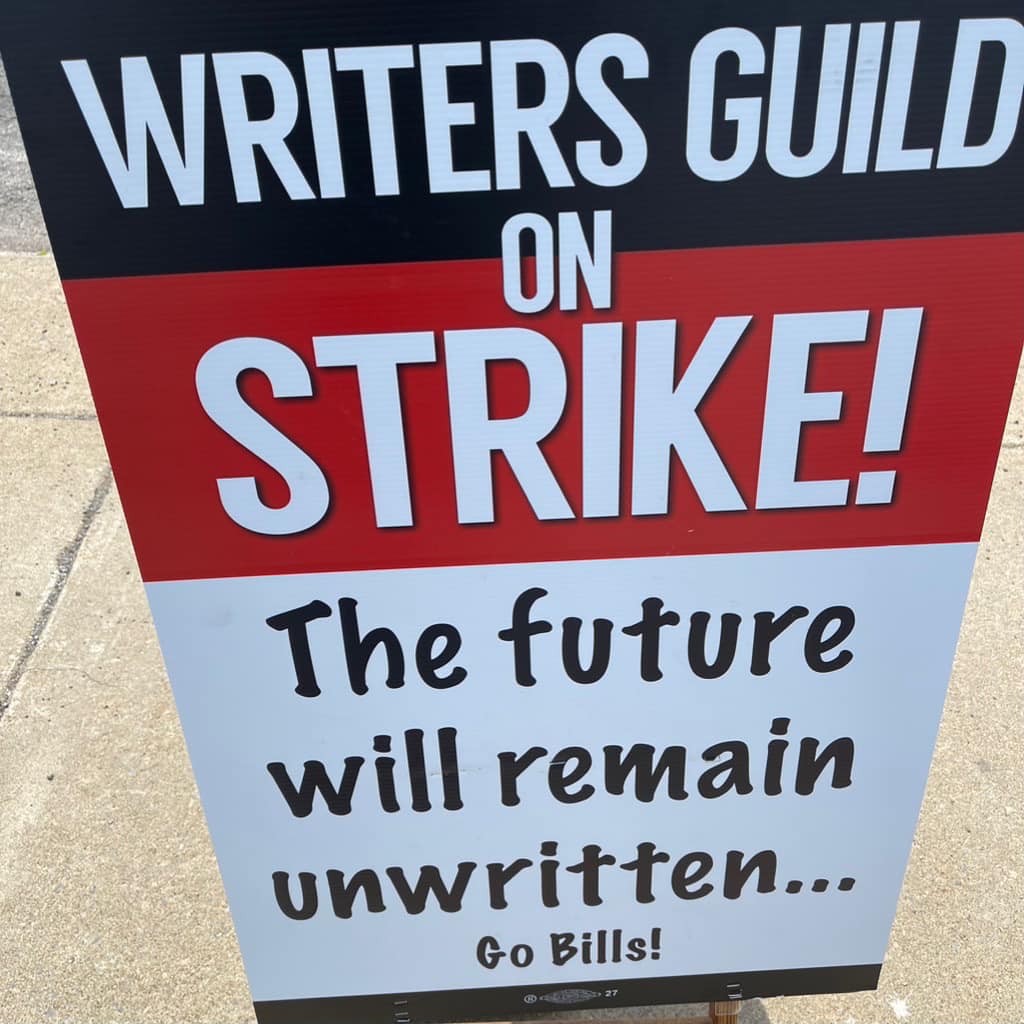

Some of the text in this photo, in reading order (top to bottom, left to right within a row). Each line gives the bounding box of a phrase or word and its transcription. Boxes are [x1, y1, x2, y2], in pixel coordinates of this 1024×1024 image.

[62, 18, 1023, 209] WRITERS GUILD
[500, 210, 613, 314] ON
[195, 307, 924, 535] STRIKE!
[266, 587, 856, 698] The future
[267, 717, 856, 818] will remain
[271, 839, 856, 921] unwritten...
[476, 927, 663, 969] Go Bills!
[605, 989, 618, 997] 27
